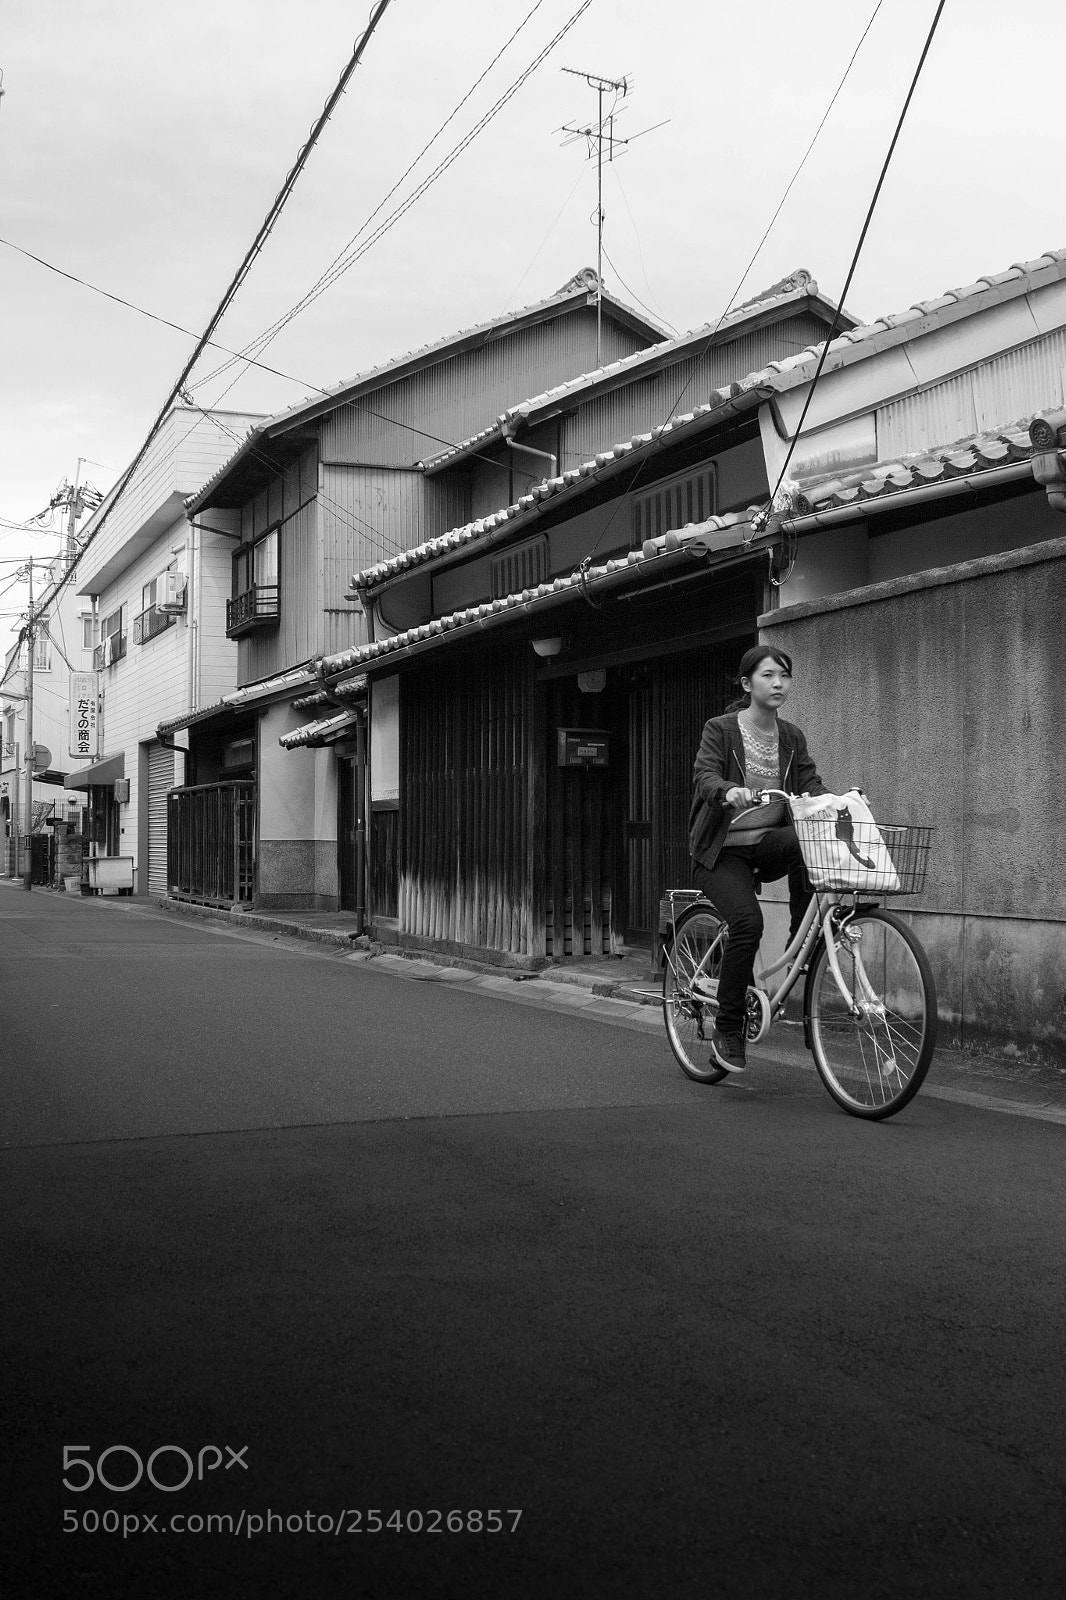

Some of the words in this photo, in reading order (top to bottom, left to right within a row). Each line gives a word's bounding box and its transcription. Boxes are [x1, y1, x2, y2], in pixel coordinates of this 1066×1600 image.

[77, 698, 91, 753] だての商会
